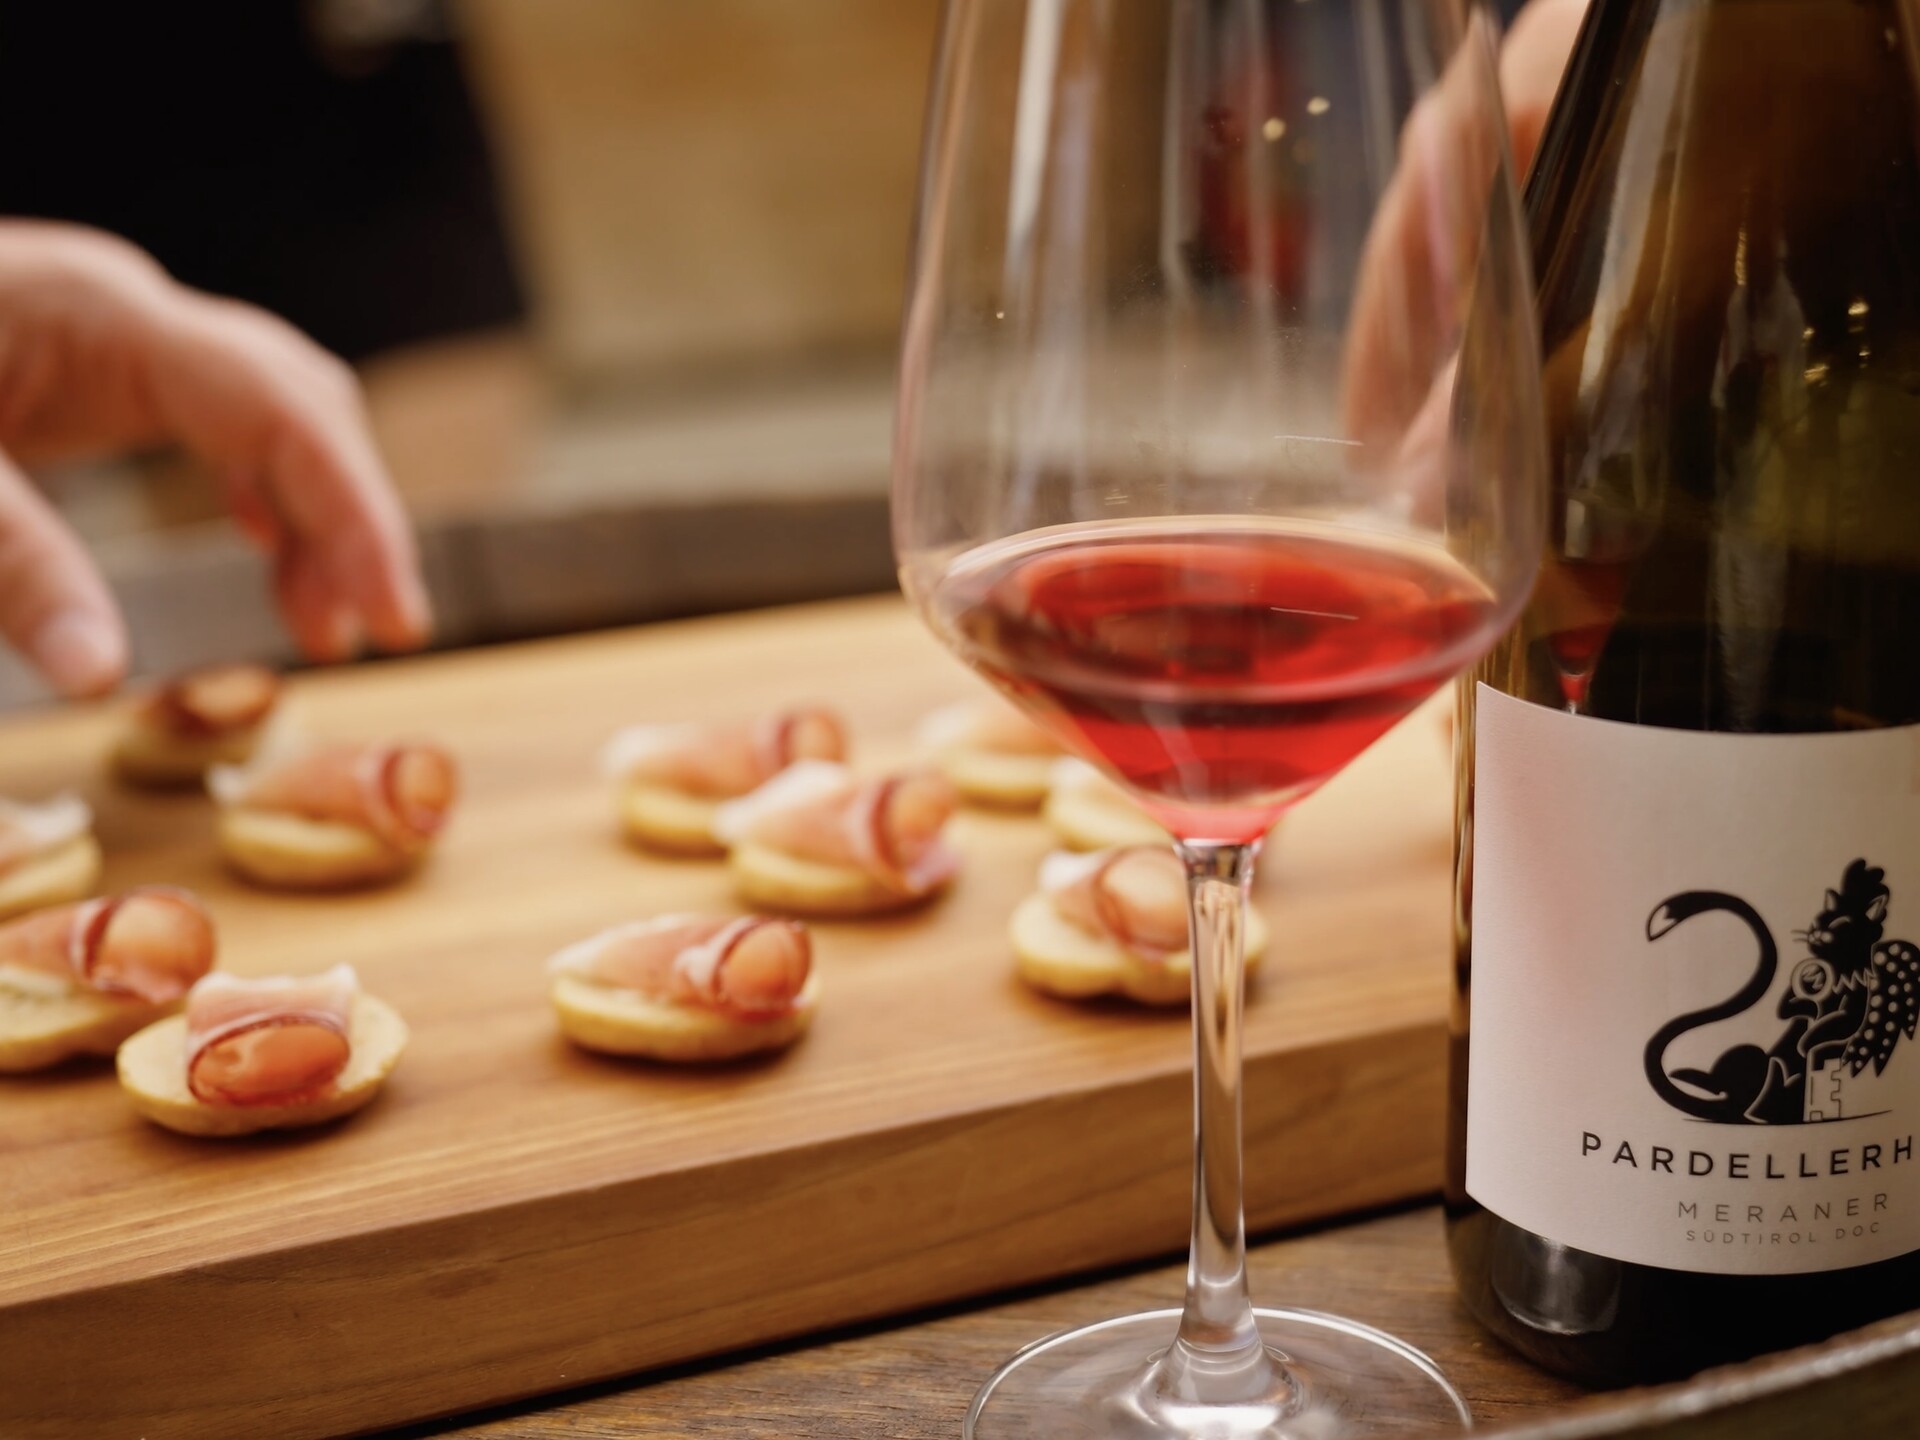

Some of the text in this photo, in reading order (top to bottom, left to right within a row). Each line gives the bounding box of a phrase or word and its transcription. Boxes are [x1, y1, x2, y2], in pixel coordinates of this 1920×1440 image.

[1582, 1131, 1912, 1179] PARDELLERH
[1678, 1193, 1888, 1223] MERANER
[1835, 1222, 1880, 1240] DOC
